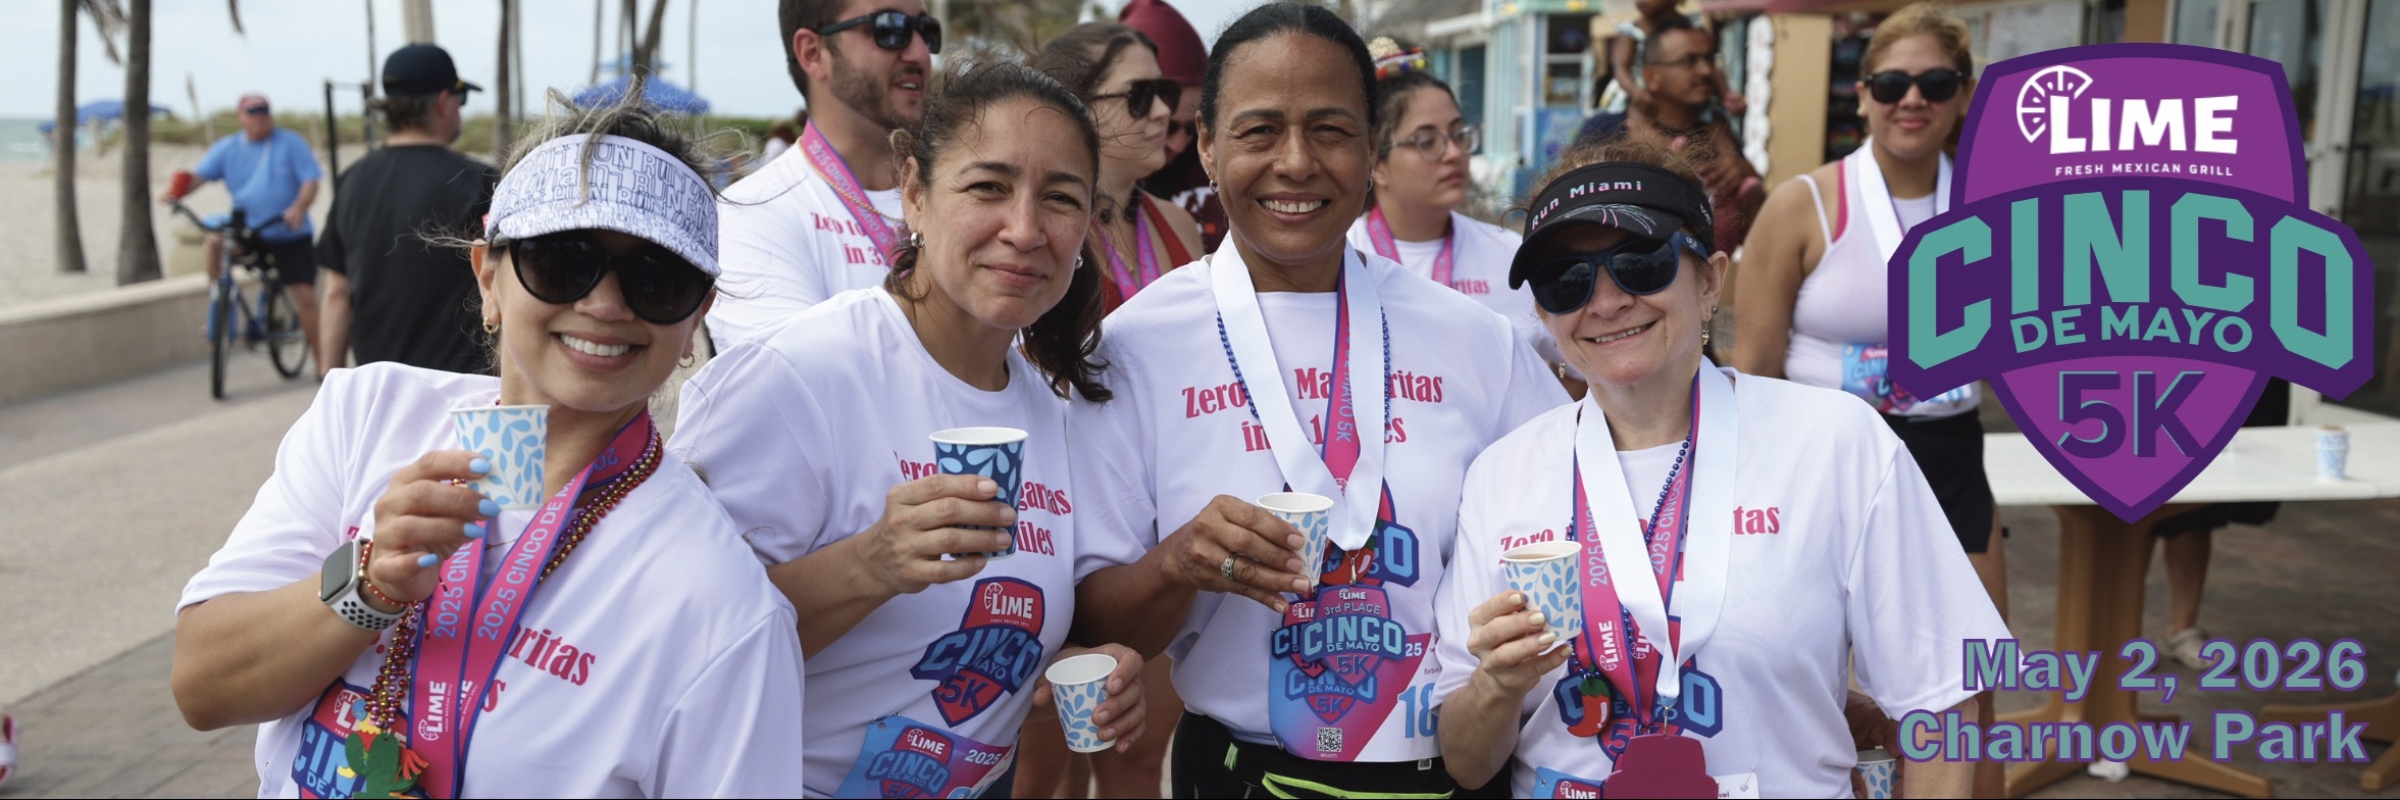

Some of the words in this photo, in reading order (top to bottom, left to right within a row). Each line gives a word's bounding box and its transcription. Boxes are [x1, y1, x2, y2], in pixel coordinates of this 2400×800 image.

[824, 161, 853, 194] CINCO
[1531, 197, 1560, 231] Run
[1570, 180, 1642, 199] Miami
[844, 243, 867, 265] in
[1181, 381, 1248, 419] Zero
[1336, 420, 1354, 443] 5K
[900, 459, 939, 482] ero
[1017, 520, 1056, 556] iles
[447, 541, 473, 583] CIN
[477, 587, 518, 641] 2025
[505, 528, 548, 585] CINCO
[540, 501, 563, 525] DE
[991, 593, 1034, 619] LIME
[1324, 604, 1341, 615] 3rd
[1344, 602, 1381, 615] PLACE
[1342, 591, 1366, 600] LIME
[434, 587, 464, 639] 2025
[1304, 616, 1402, 656] CINCO
[1326, 642, 1343, 652] DE
[1346, 641, 1380, 652] MAYO
[1598, 620, 1619, 663] LIME
[504, 622, 596, 686] ritas
[919, 628, 1041, 689] CINCO
[1405, 643, 1422, 657] 25
[1336, 655, 1370, 675] 5K
[937, 674, 989, 712] 5K
[1308, 684, 1323, 693] DE
[1325, 684, 1355, 695] MAYO
[426, 681, 447, 733] LIME
[1316, 696, 1344, 713] 5K
[911, 735, 945, 755] LIME
[965, 749, 1002, 765] 2025
[306, 770, 329, 797] DE
[870, 752, 950, 792] CINCO
[1565, 787, 1597, 799] LIME
